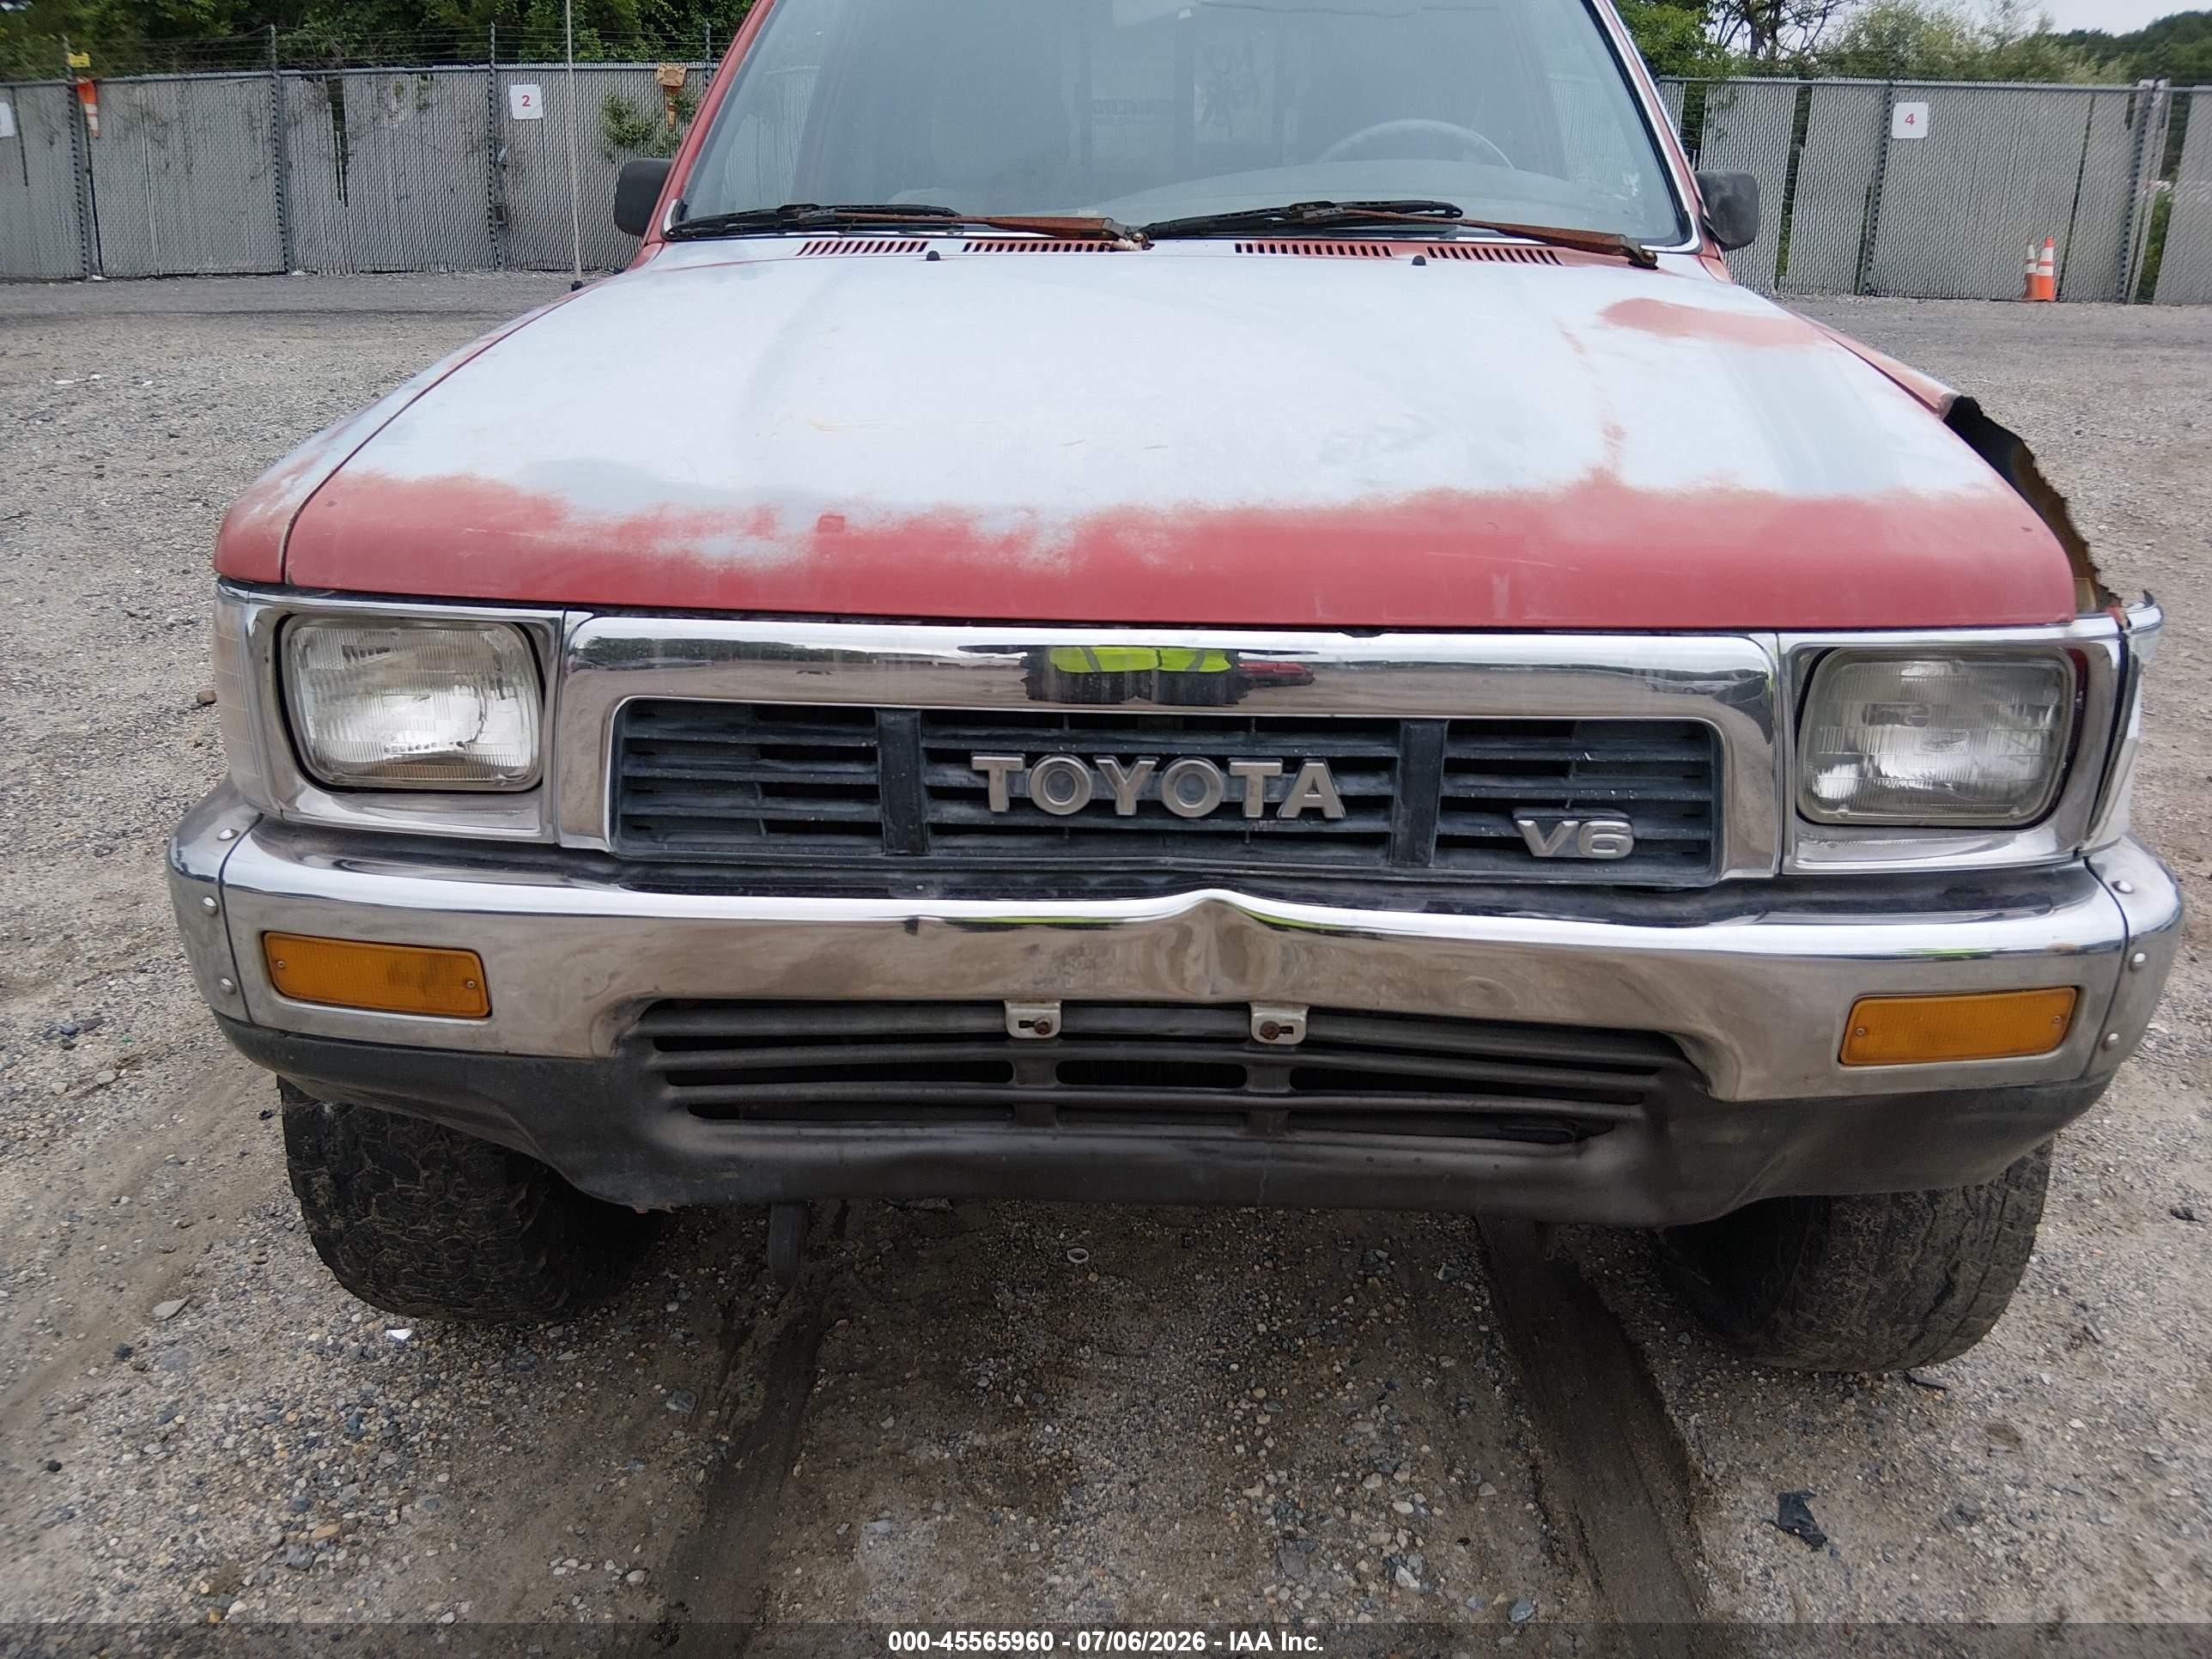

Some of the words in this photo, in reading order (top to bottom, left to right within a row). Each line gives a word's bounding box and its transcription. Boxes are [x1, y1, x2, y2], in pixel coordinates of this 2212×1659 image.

[521, 94, 531, 107] 2
[1905, 113, 1916, 125] 4
[970, 753, 1346, 819] TOYOTA
[1514, 817, 1635, 859] V6
